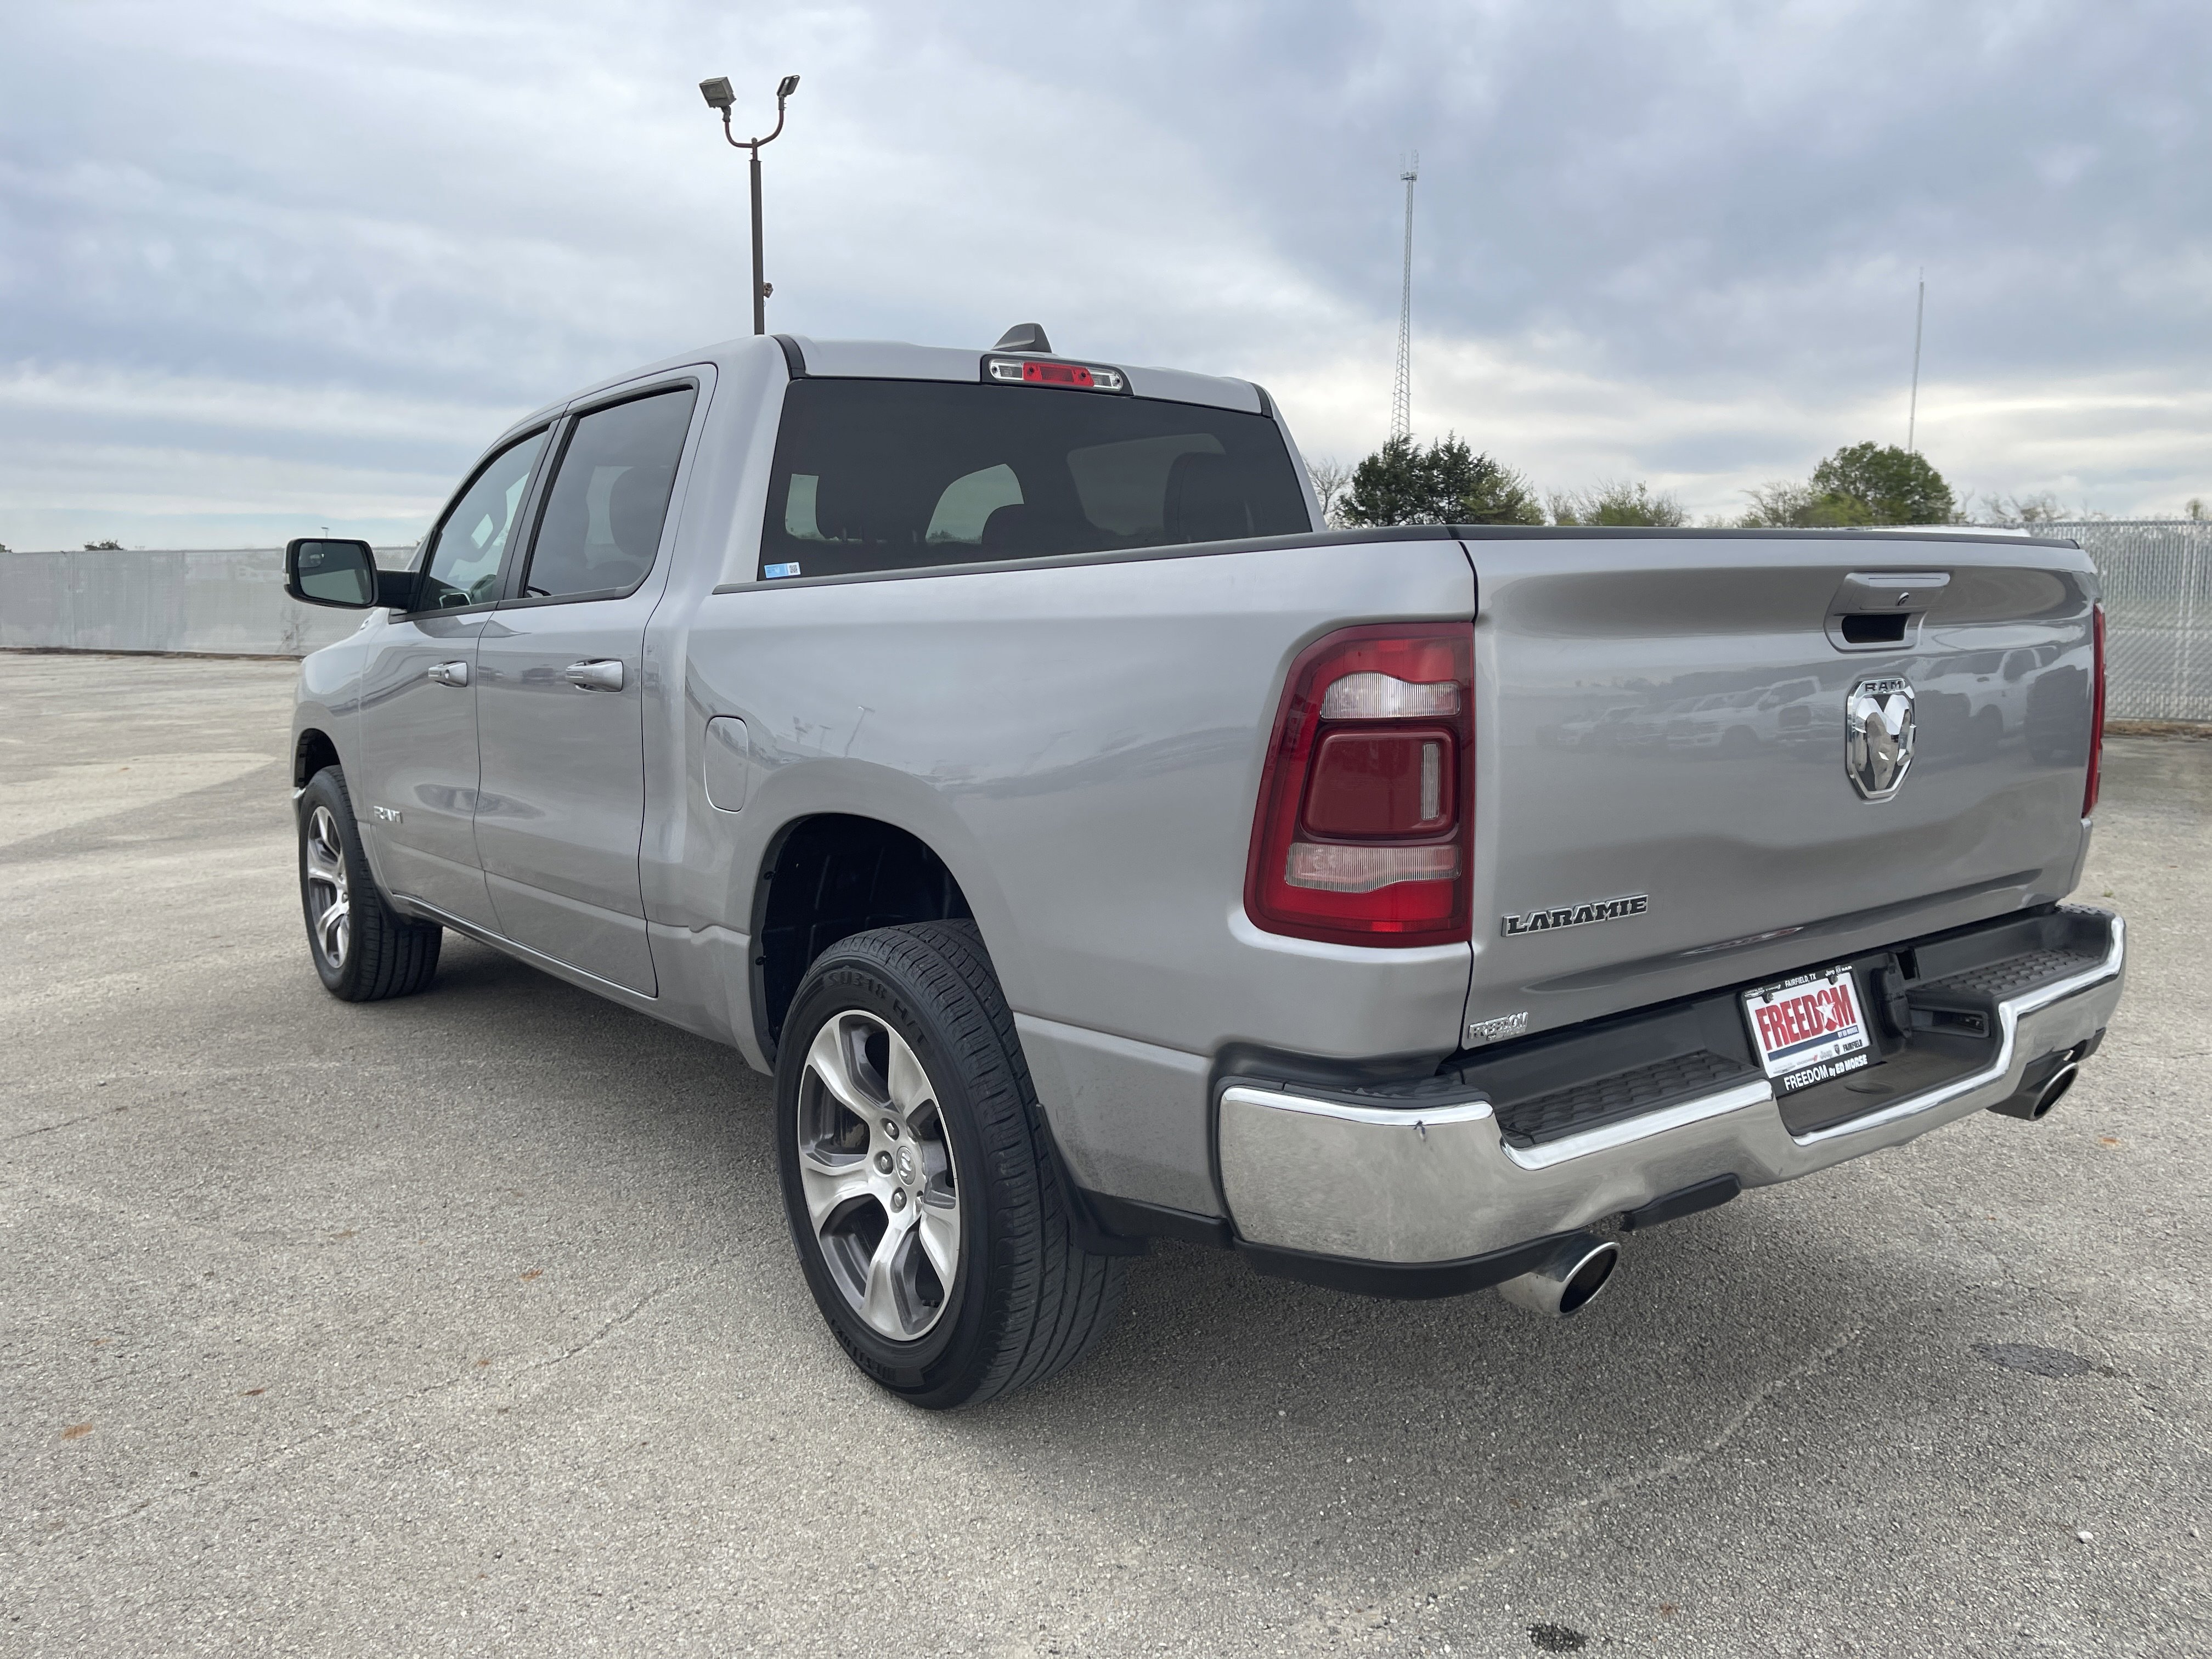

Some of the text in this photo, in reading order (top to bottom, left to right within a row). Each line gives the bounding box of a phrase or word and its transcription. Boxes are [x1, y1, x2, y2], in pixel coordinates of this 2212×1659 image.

[1865, 681, 1903, 691] RAM
[1502, 894, 1649, 936] LARAMIE
[1785, 975, 1810, 988] FAIRFIELD,
[1755, 984, 1857, 1051] FREEDOM
[1784, 1064, 1829, 1091] FREEDOM
[1835, 1062, 1845, 1074] ED
[1844, 1054, 1868, 1071] MORSE
